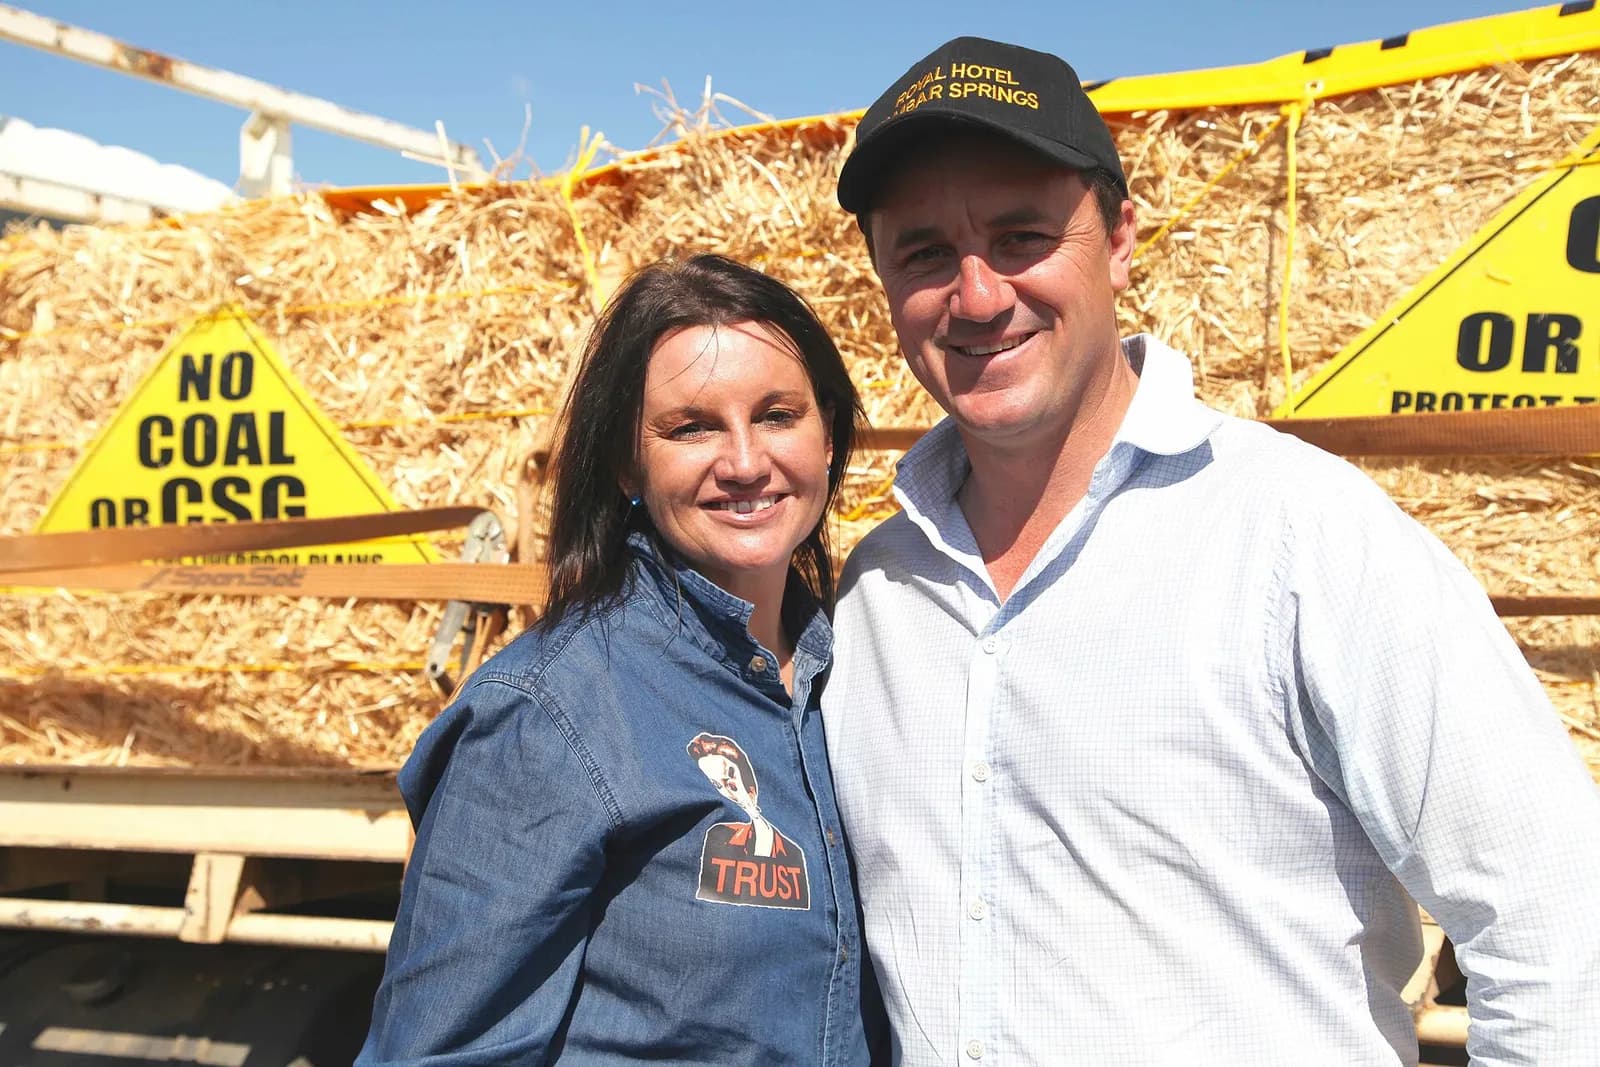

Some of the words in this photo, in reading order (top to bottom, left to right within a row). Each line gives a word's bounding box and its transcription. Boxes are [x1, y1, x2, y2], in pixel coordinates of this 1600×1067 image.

[895, 66, 947, 107] ROYAL
[951, 63, 1020, 86] HOTEL
[949, 82, 1039, 110] SPRINGS
[1456, 311, 1583, 374] OR
[178, 351, 255, 402] NO
[138, 411, 296, 469] COAL
[91, 498, 149, 528] OR
[161, 475, 306, 525] CSG
[711, 857, 801, 900] TRUST
